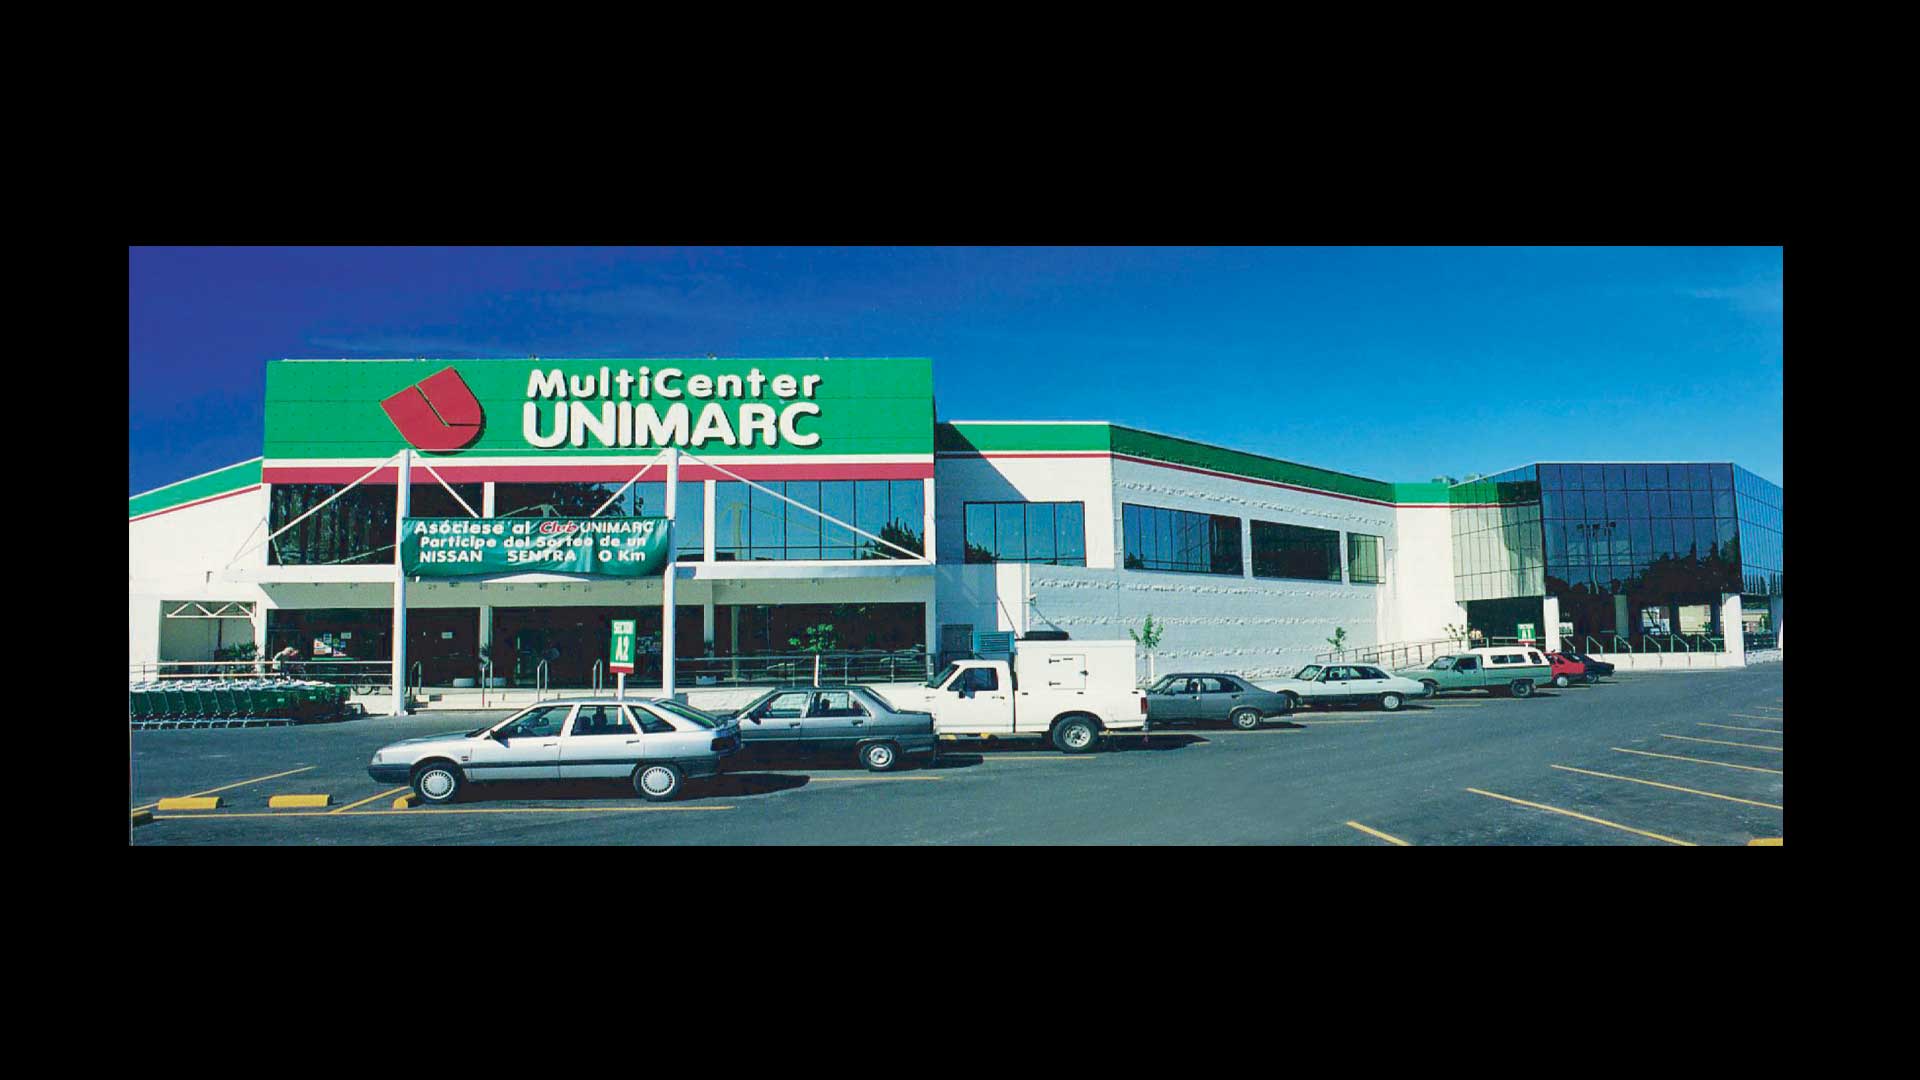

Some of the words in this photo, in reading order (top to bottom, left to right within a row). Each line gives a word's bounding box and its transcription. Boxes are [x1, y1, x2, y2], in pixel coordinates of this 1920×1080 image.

[526, 366, 822, 399] MultiCenter
[522, 401, 821, 448] UNIMARC
[512, 520, 530, 534] al
[540, 520, 578, 534] Club
[580, 521, 654, 533] UNIMARC
[421, 535, 497, 549] Participe
[504, 535, 530, 548] del
[536, 536, 593, 548] Sorteo
[600, 535, 620, 547] de
[627, 537, 646, 548] un
[420, 550, 483, 563] NISSAN
[507, 549, 577, 562] SENTRA
[618, 550, 646, 562] Km
[615, 635, 630, 661] A2
